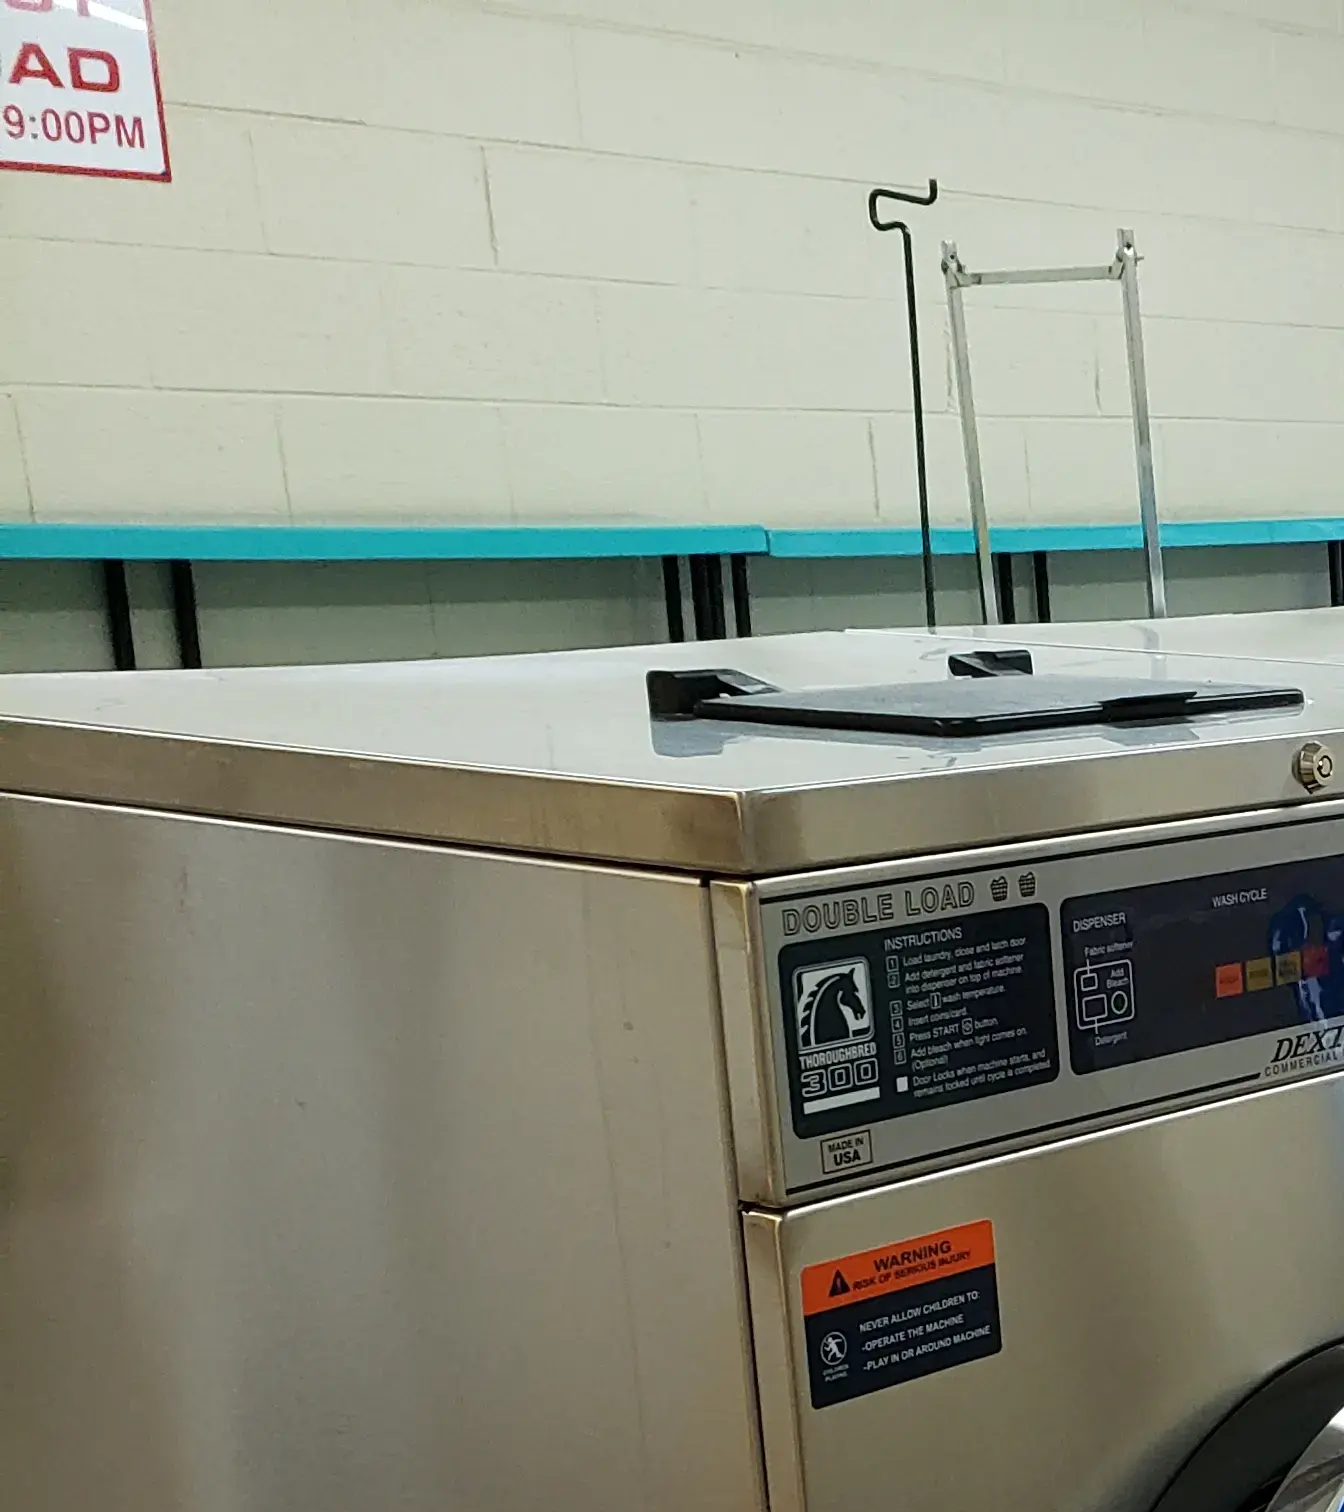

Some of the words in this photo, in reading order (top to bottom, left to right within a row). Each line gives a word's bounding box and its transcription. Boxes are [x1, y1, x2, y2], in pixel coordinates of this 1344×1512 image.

[3, 104, 145, 149] 9:00PM
[781, 892, 895, 936] DOUBLE
[903, 880, 976, 916] LOAD
[1212, 892, 1238, 907] WASH
[1239, 888, 1267, 903] CYCLE
[1073, 911, 1126, 932] DISPENSER
[884, 926, 962, 950] INSTRUCTIONS
[1084, 943, 1105, 956] Fabric
[902, 954, 922, 966] Load
[954, 945, 974, 956] close
[975, 942, 990, 953] and
[904, 971, 919, 982] Add
[920, 964, 956, 981] detergent
[957, 961, 972, 972] and
[920, 976, 957, 992] dispenser
[958, 975, 968, 984] on
[969, 972, 981, 983] top
[982, 970, 990, 979] of
[1106, 975, 1128, 988] Bleach
[1110, 967, 1124, 978] Add
[906, 997, 929, 1010] Select
[907, 1014, 928, 1026] Insert
[909, 1029, 931, 1042] Press
[932, 1023, 959, 1037] START
[910, 1047, 926, 1058] Add
[927, 1041, 952, 1054] bleach
[953, 1037, 973, 1049] when
[991, 1029, 1015, 1041] comes
[1094, 1031, 1129, 1046] Detergent
[798, 1041, 876, 1070] THOROUGHBRED
[912, 1073, 931, 1086] Door
[932, 1068, 954, 1081] Locks
[956, 1064, 976, 1076] when
[977, 1057, 1007, 1071] machine
[1031, 1048, 1045, 1059] and
[1264, 1049, 1338, 1077] COMMERCIAL
[800, 1057, 878, 1098] 300
[944, 1077, 969, 1090] locked
[970, 1074, 985, 1084] until
[987, 1070, 1005, 1083] cycle
[1006, 1068, 1013, 1076] is
[828, 1139, 852, 1152] MADE
[855, 1136, 863, 1146] IN
[833, 1148, 860, 1166] USA
[873, 1239, 951, 1272] WARNING
[853, 1276, 877, 1290] RISK
[878, 1272, 891, 1283] OF
[894, 1260, 935, 1279] SERIOUS
[938, 1249, 971, 1266] INJURY
[859, 1316, 888, 1332] NEVER
[890, 1307, 921, 1323] ALLOW
[922, 1294, 964, 1314] CHILDREN
[966, 1289, 980, 1301] TO:
[861, 1330, 905, 1353] -OPERATE
[907, 1324, 924, 1338] THE
[926, 1313, 963, 1333] MACHINE
[863, 1355, 889, 1371] -PLAY
[890, 1352, 899, 1363] IN
[901, 1348, 913, 1359] OR
[915, 1336, 951, 1355] AROUND
[953, 1324, 990, 1343] MACHINE
